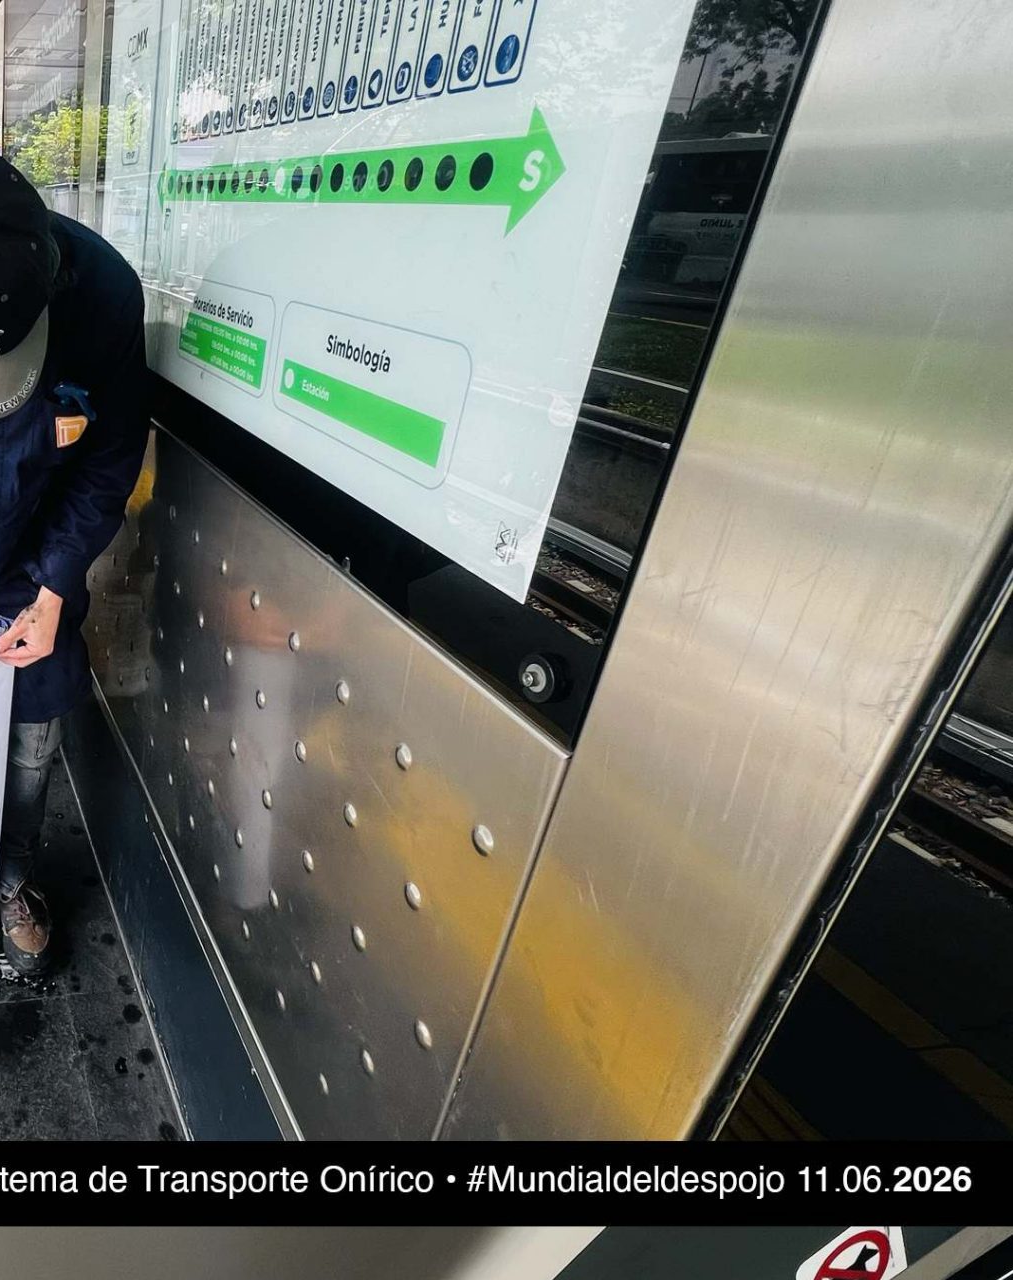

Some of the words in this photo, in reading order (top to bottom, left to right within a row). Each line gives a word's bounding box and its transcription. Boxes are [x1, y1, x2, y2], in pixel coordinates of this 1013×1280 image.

[127, 27, 149, 58] CDMX
[290, 28, 303, 86] ESTADIO
[519, 150, 545, 191] S
[193, 296, 217, 316] Horarios
[217, 304, 226, 319] de
[226, 305, 254, 329] Servicio
[326, 334, 391, 373] Simbología
[18, 368, 38, 399] YORK
[301, 379, 330, 402] Estación
